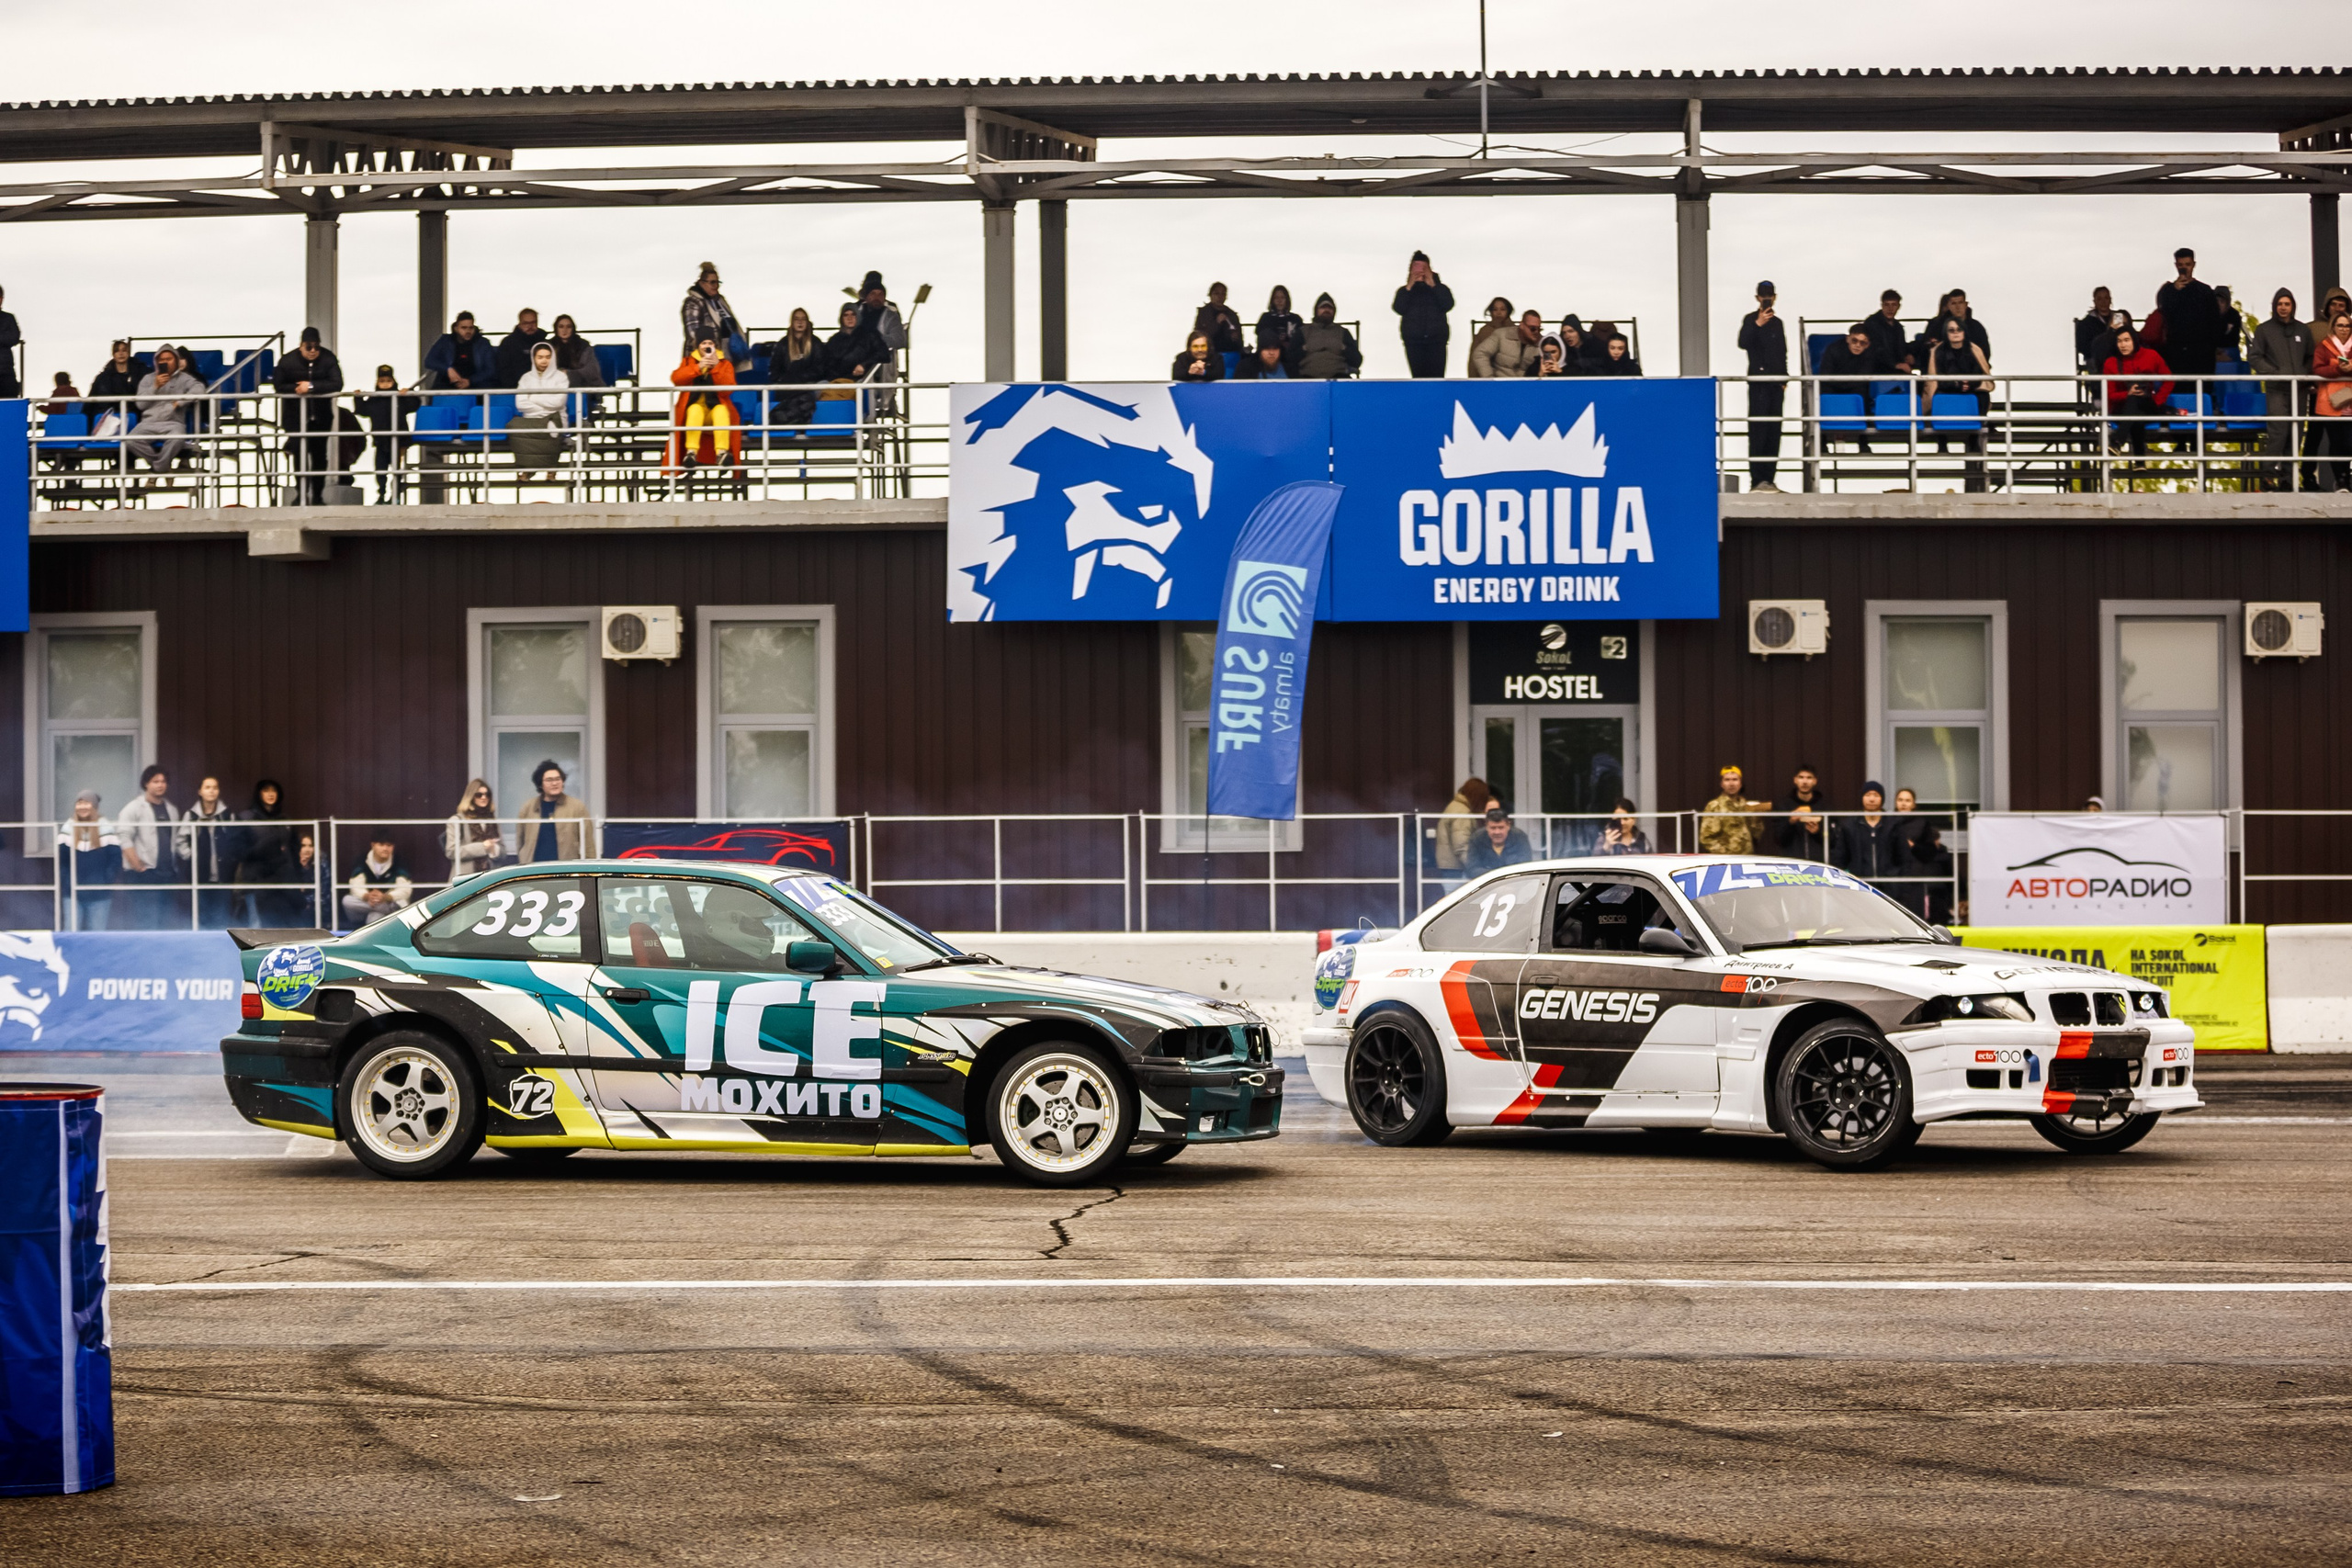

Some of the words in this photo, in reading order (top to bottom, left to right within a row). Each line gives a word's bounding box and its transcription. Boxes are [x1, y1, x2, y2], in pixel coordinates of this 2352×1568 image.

[1399, 487, 1654, 566] GORILLA
[1434, 577, 1535, 603] ENERGY
[1541, 576, 1621, 602] DRINK
[1504, 675, 1604, 699] HOSTEL
[2007, 878, 2192, 898] АВТОРАДИО
[471, 890, 585, 937] 333
[815, 901, 856, 926] 333
[1473, 893, 1516, 937] 13
[2131, 963, 2219, 974] INTERNATIONAL
[2151, 950, 2186, 961] SOKOL
[88, 977, 167, 1000] POWER
[175, 978, 233, 1000] YOUR
[1520, 989, 1660, 1023] GENESIS
[684, 980, 887, 1079] ICE
[513, 1081, 554, 1111] 72
[681, 1077, 882, 1118] МОХИТО
